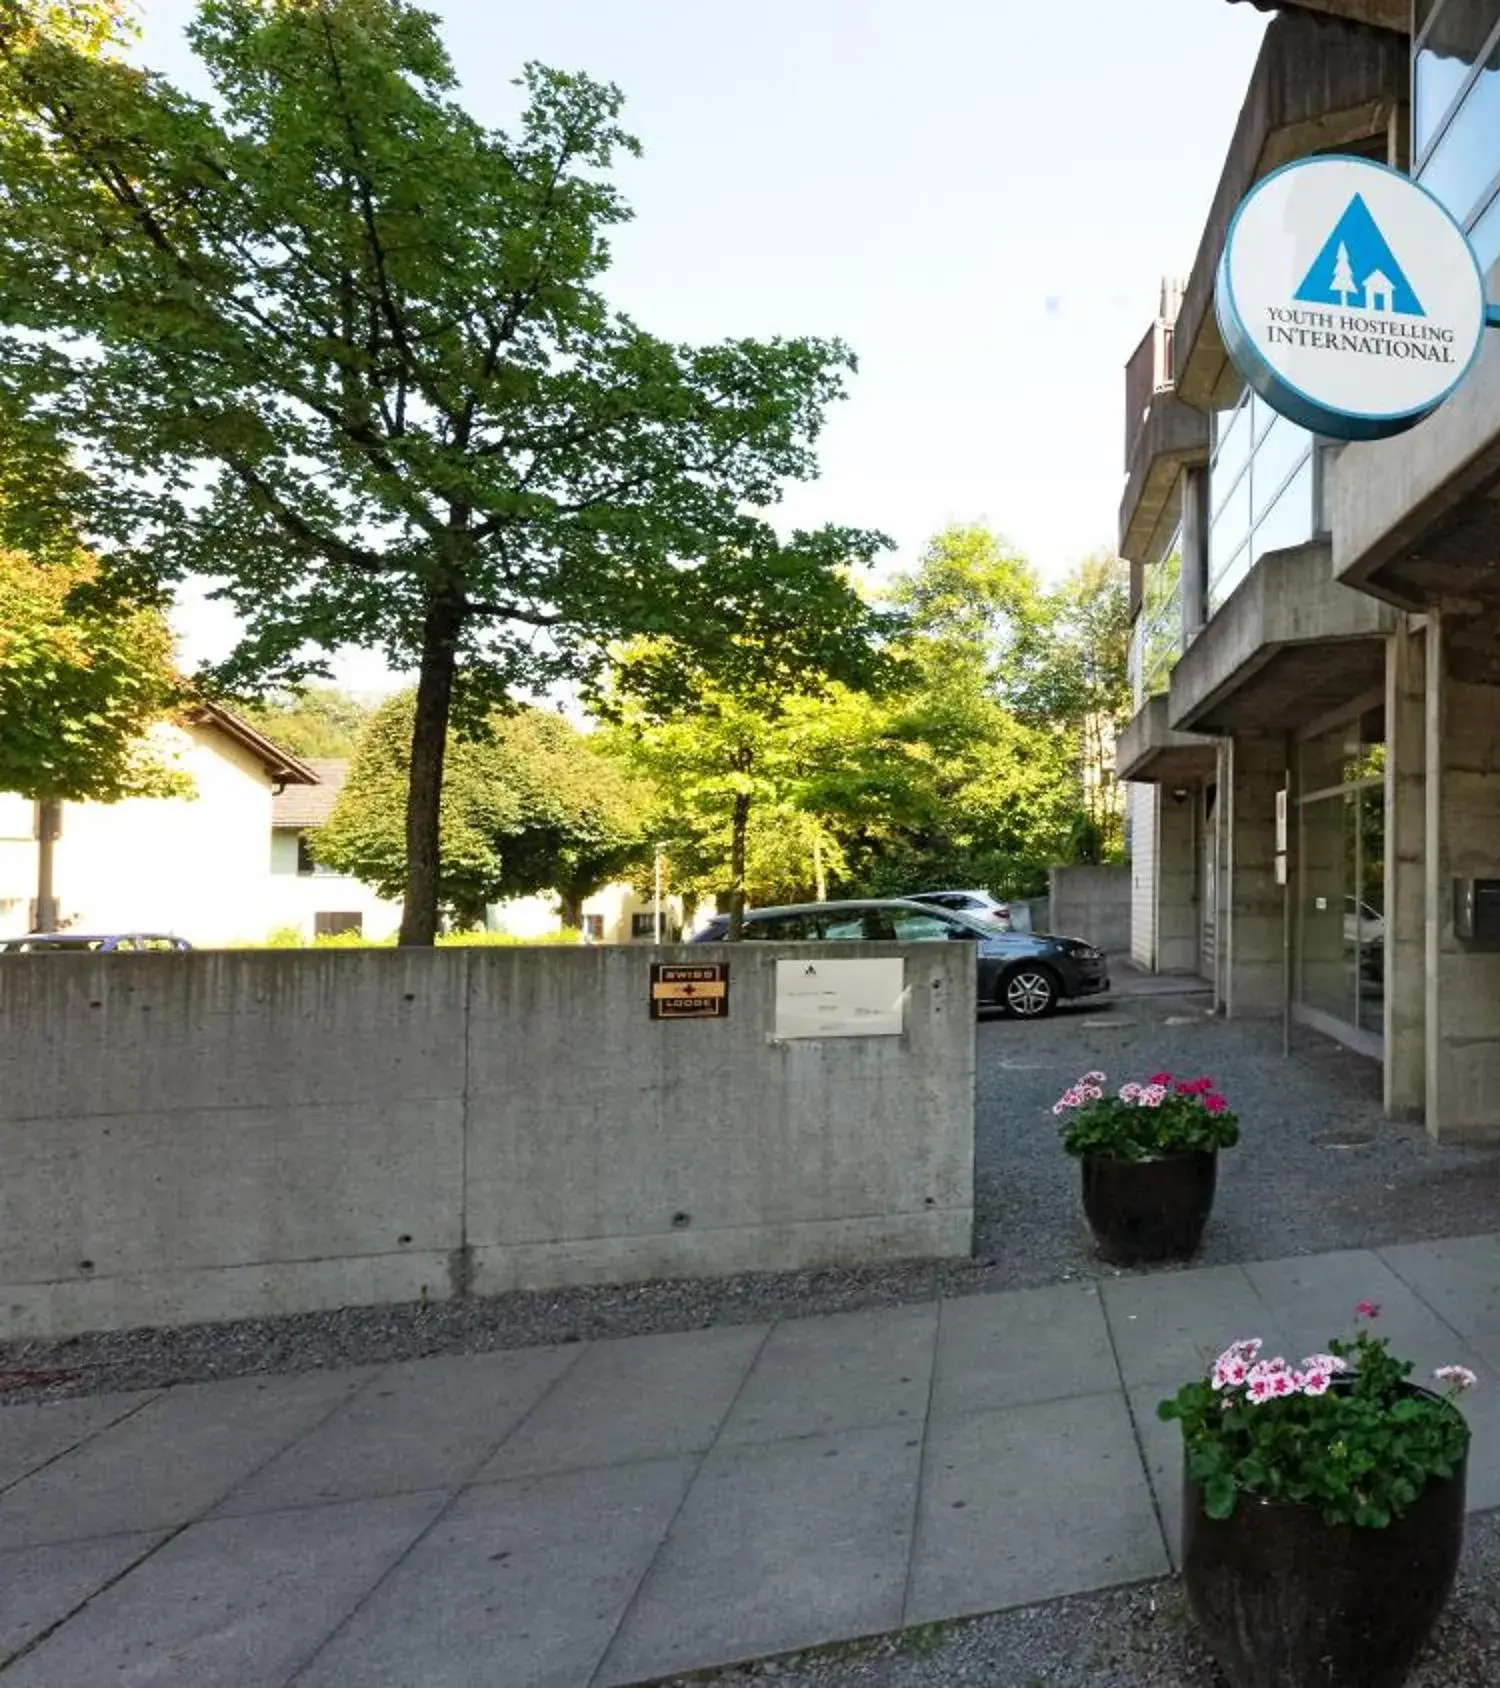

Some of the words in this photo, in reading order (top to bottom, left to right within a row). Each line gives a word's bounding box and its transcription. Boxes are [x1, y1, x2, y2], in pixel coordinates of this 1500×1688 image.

[1268, 307, 1333, 329] YOUTH
[1340, 316, 1455, 343] HOSTELLING
[1268, 325, 1456, 363] INTERNATIONAL
